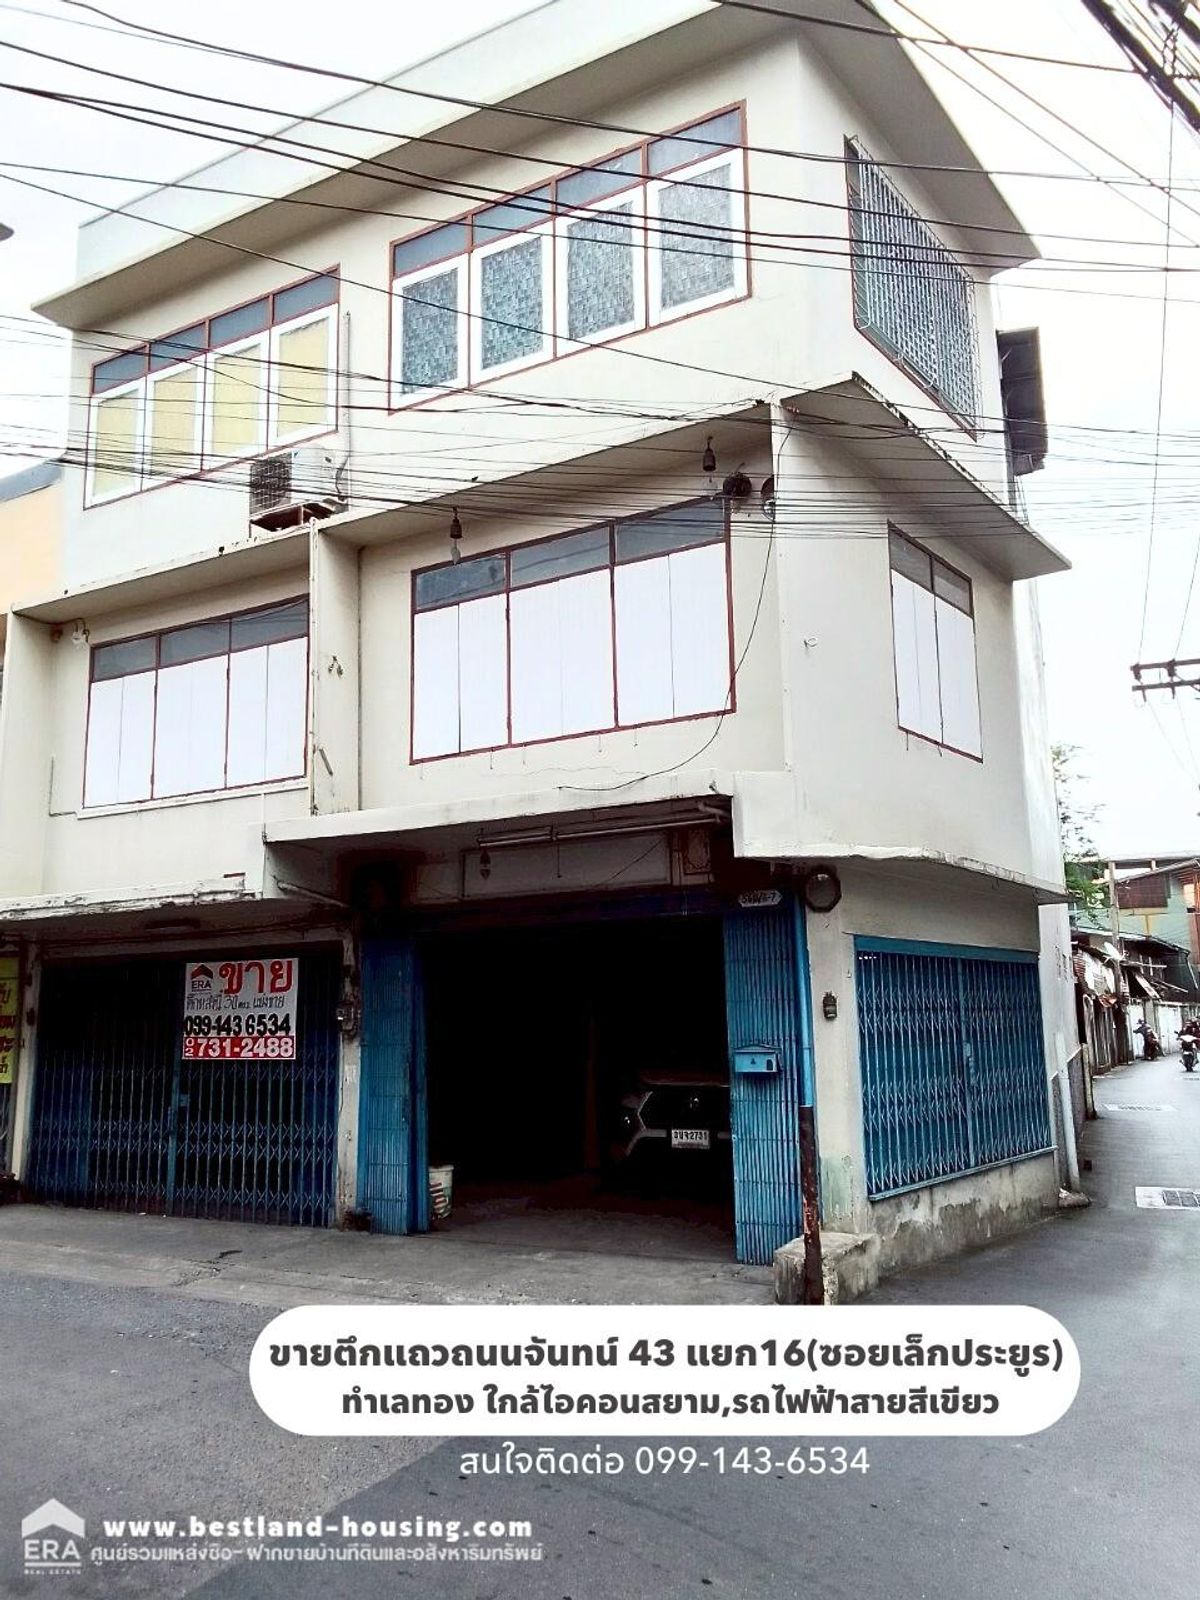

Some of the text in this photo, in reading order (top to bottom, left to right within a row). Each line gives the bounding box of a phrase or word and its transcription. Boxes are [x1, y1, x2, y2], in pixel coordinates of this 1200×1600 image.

[191, 980, 212, 989] ERA
[219, 960, 293, 994] ขาย
[198, 1037, 293, 1058] 731-2488
